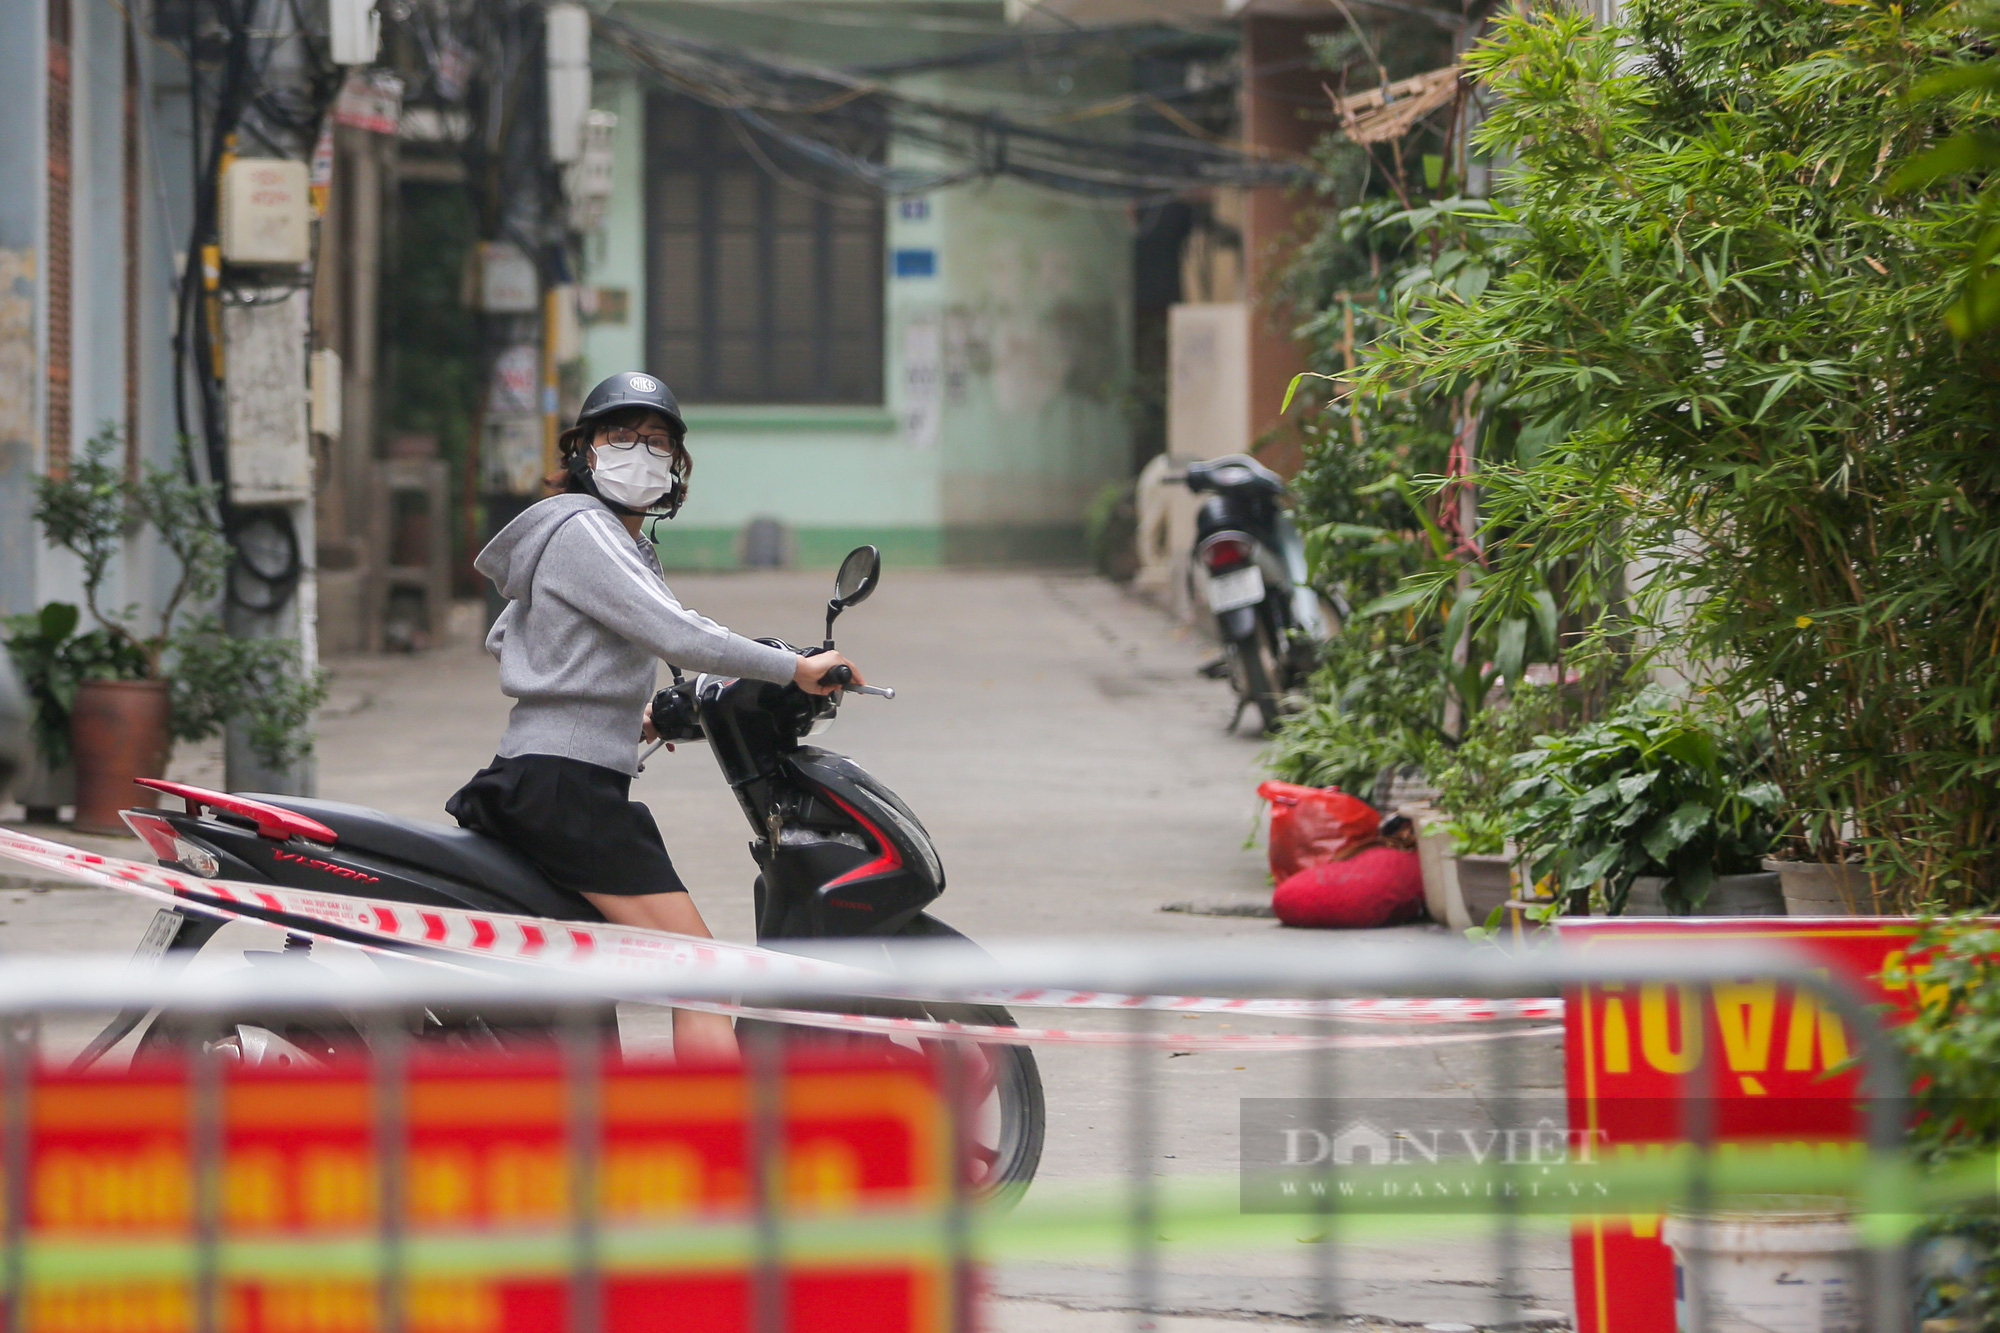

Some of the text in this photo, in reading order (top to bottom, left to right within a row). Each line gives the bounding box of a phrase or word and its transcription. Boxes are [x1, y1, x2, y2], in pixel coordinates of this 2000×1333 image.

[631, 377, 656, 391] NIKE
[271, 847, 379, 884] VISION
[830, 899, 874, 911] HONDA
